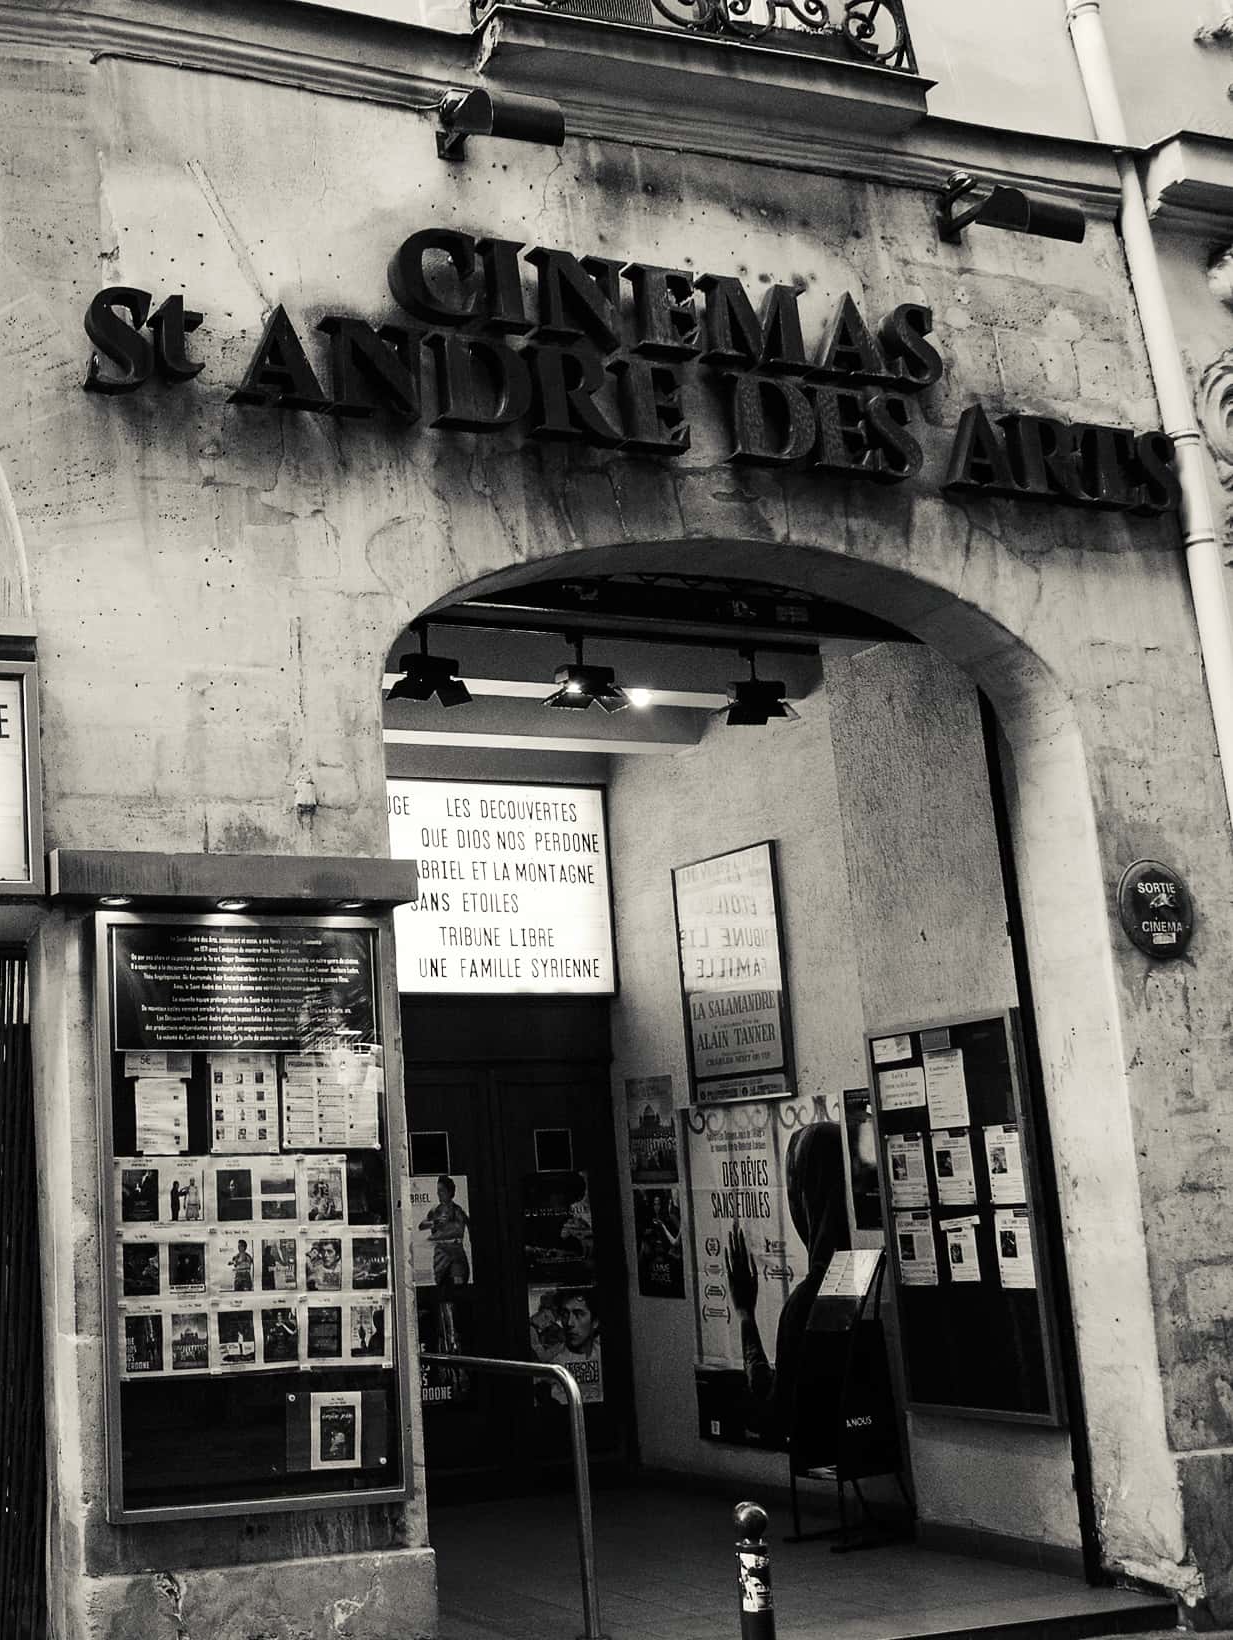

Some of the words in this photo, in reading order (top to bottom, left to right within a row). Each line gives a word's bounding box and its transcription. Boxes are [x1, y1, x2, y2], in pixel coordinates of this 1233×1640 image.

[388, 228, 943, 392] CINEMAS
[84, 287, 205, 394] St
[227, 303, 691, 448] ANDRE
[727, 372, 923, 484] DES
[941, 403, 1182, 517] ARTS
[447, 798, 470, 817] LES
[481, 800, 576, 822] DECOUVERTES
[422, 828, 448, 847] QUE
[457, 830, 490, 849] DIOS
[497, 831, 525, 850] NOS
[535, 832, 599, 853] PERDONE
[417, 860, 464, 880] BRIEL
[472, 862, 486, 880] ET
[494, 862, 510, 880] LA
[516, 863, 595, 884] MONTAGNE
[1137, 882, 1176, 894] SORTIE
[463, 893, 518, 913] ETOILES
[439, 927, 500, 946] TRIBUNE
[510, 928, 554, 947] LIBRE
[1142, 921, 1182, 932] CINEMA
[419, 958, 447, 977] UNE
[461, 959, 521, 977] FAMILLE
[532, 959, 600, 978] SYRIENNE
[693, 1002, 706, 1020] LA
[708, 991, 776, 1018] SALAMANDRE
[697, 1030, 729, 1051] ALAIN
[734, 1023, 776, 1045] TANNER
[722, 1161, 739, 1187] DES
[741, 1155, 769, 1187] RÊVES
[711, 1192, 734, 1218] SANS
